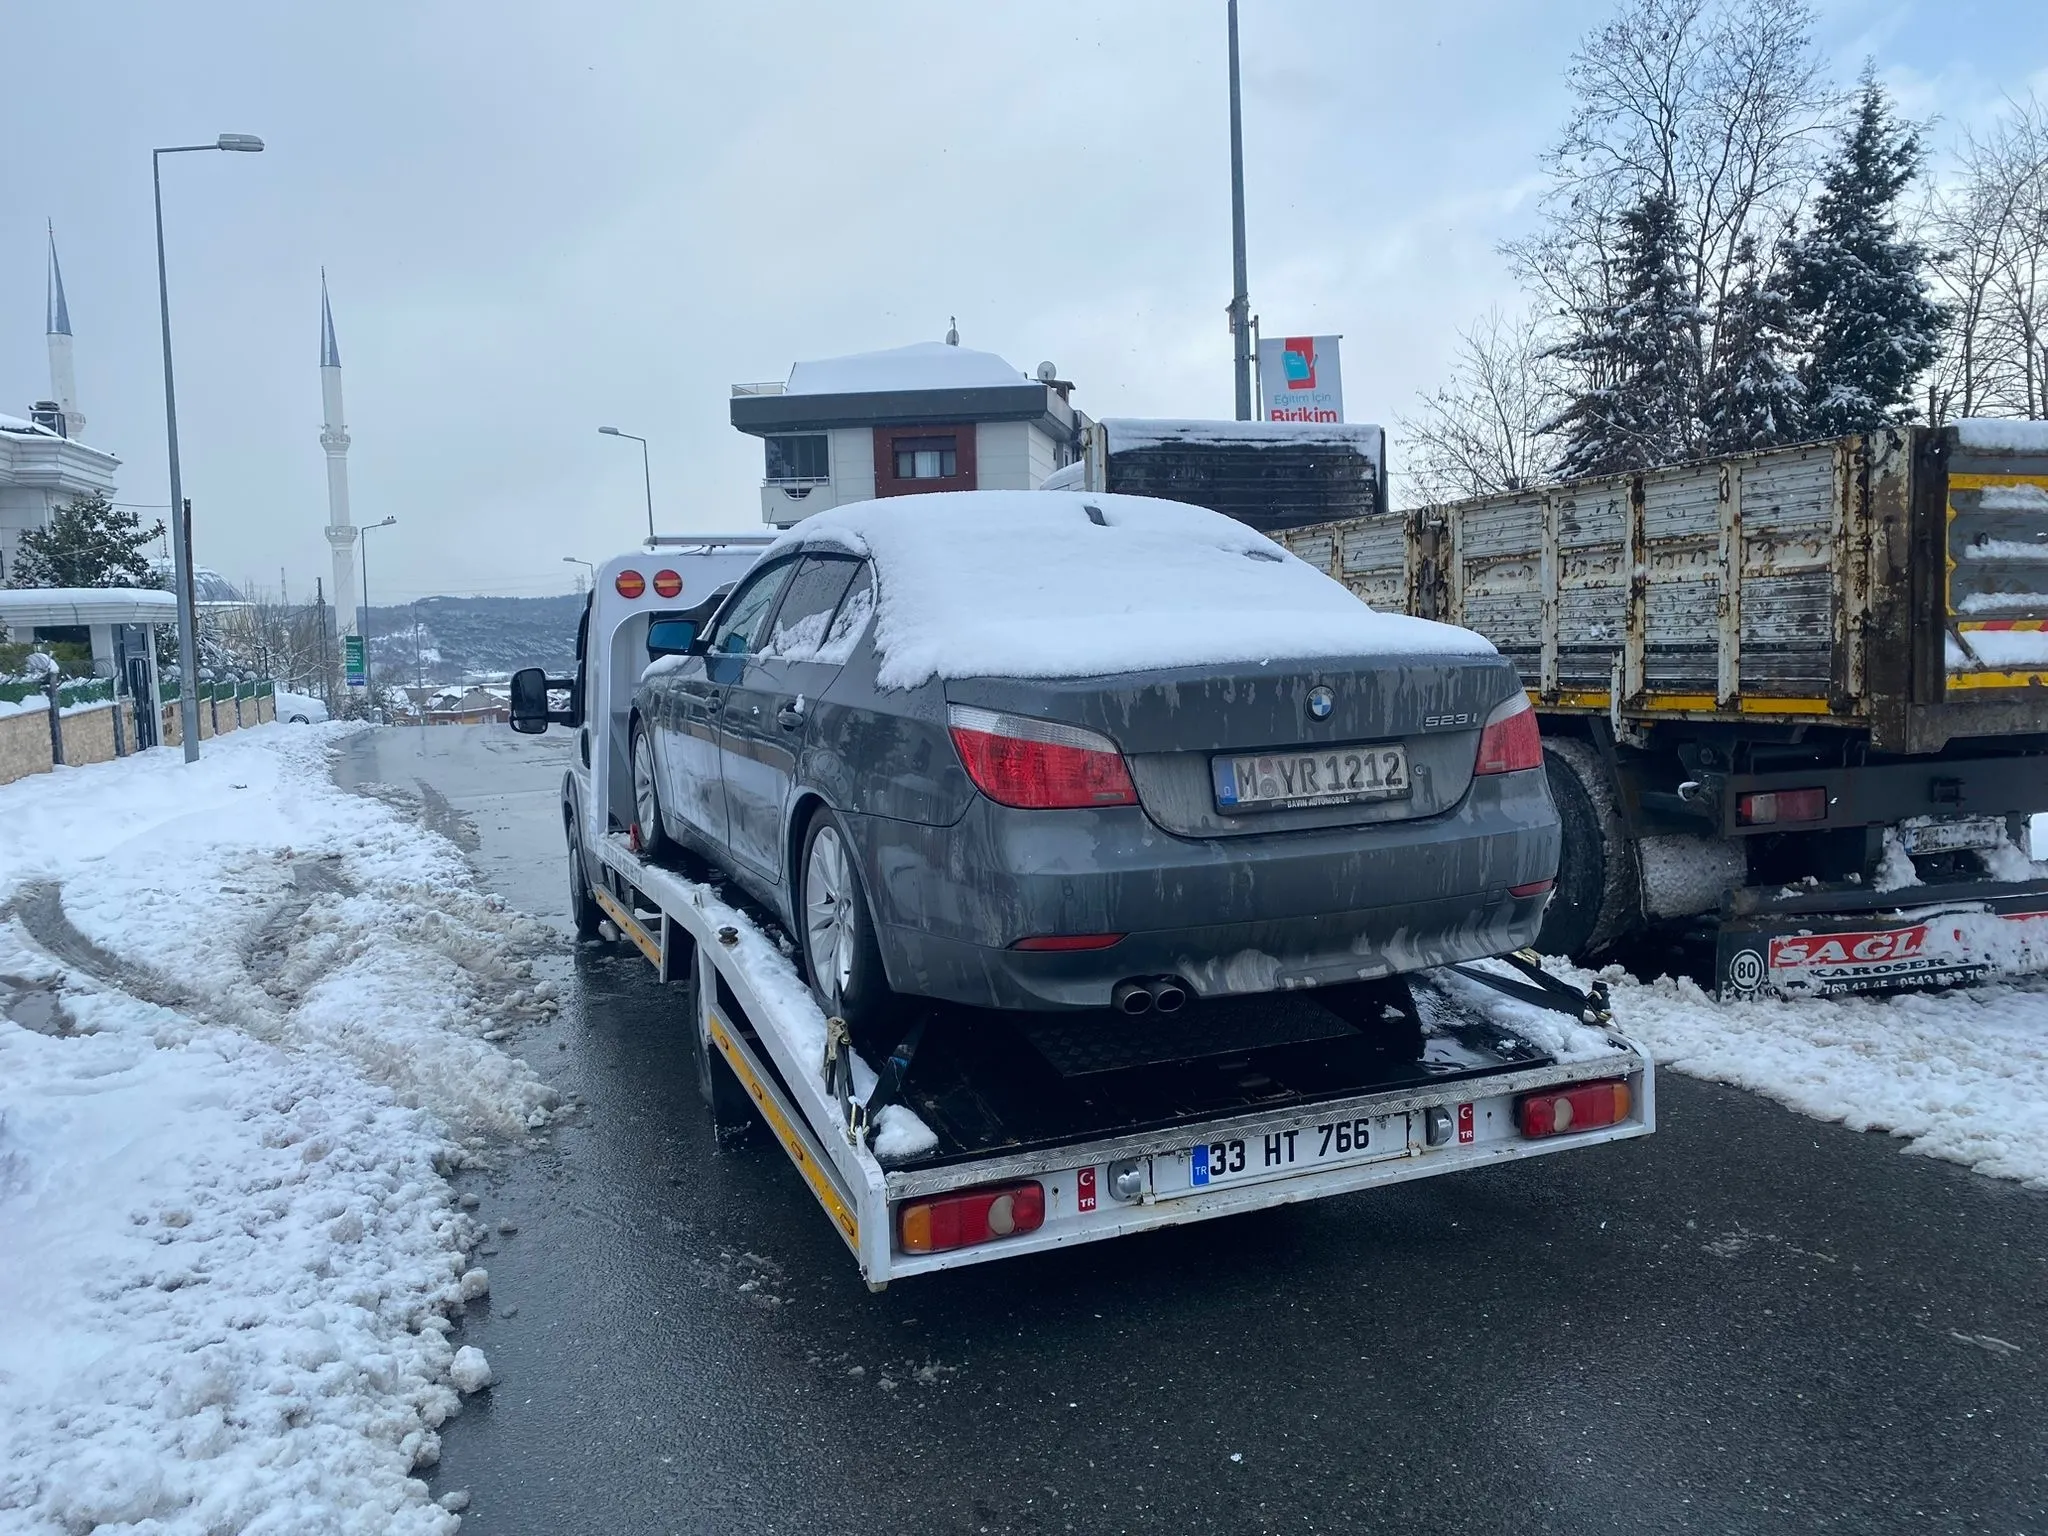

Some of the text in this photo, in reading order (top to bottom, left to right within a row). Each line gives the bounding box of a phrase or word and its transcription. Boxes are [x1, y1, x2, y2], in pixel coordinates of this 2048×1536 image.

[1271, 406, 1337, 423] Birikim
[1738, 961, 1756, 978] 80
[1461, 1130, 1473, 1139] TR
[1195, 1118, 1369, 1176] TR 33 HT 766
[1080, 1197, 1095, 1208] TR
